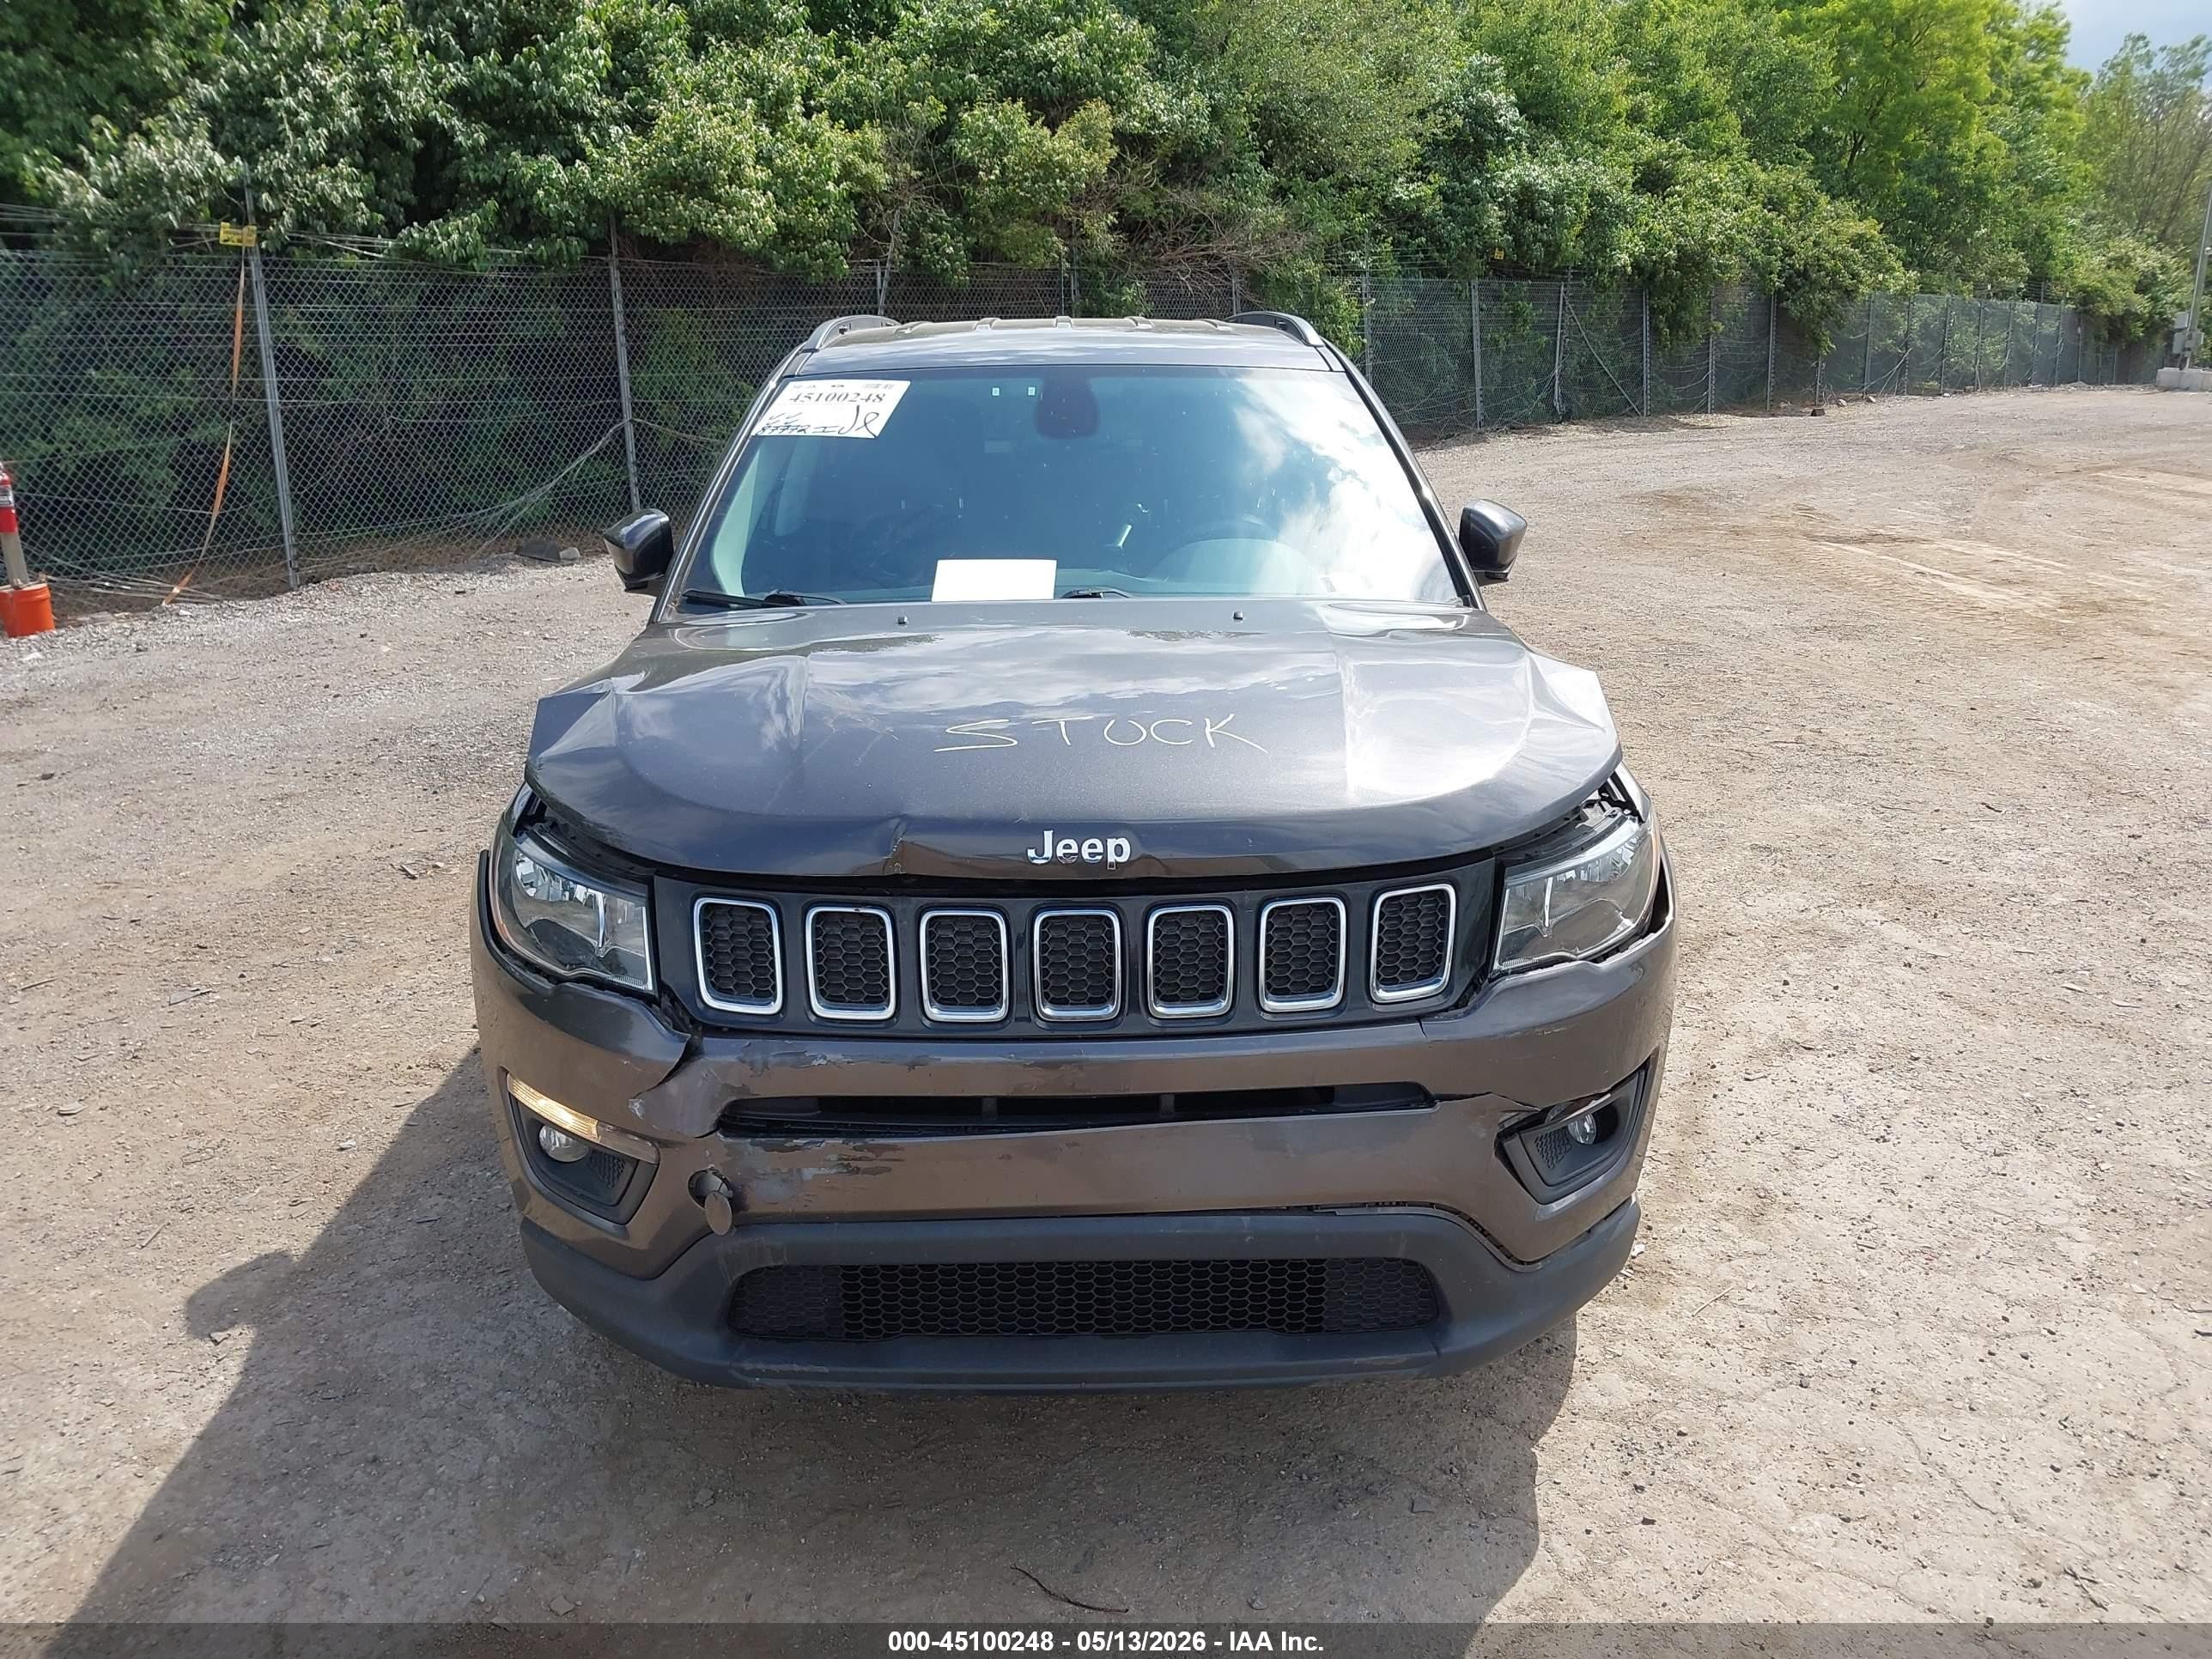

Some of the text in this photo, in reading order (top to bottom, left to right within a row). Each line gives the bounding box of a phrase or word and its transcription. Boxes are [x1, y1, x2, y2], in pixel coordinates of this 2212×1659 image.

[789, 392, 886, 403] 45100248
[933, 714, 1268, 753] STUCK
[1027, 830, 1132, 871] Jeep
